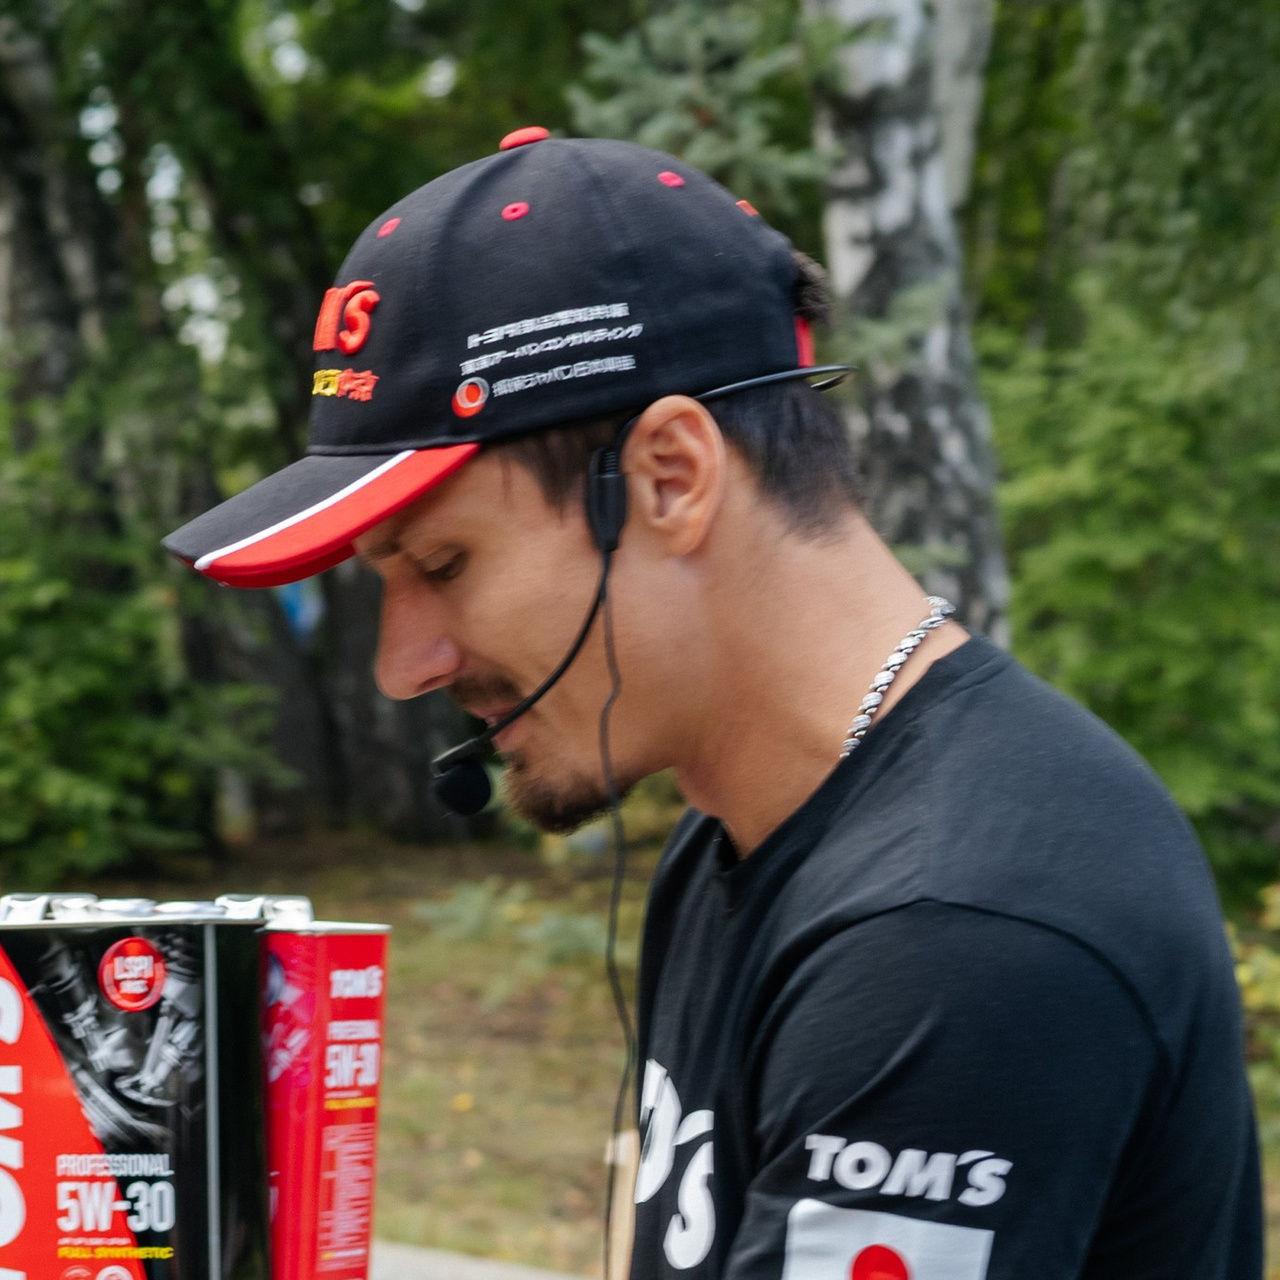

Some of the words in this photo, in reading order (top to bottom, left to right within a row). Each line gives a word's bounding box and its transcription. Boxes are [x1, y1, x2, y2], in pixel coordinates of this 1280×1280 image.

[56, 1154, 175, 1177] PROFESSIONAL
[805, 1133, 1013, 1207] TOM'S
[56, 1181, 176, 1233] 5W-30
